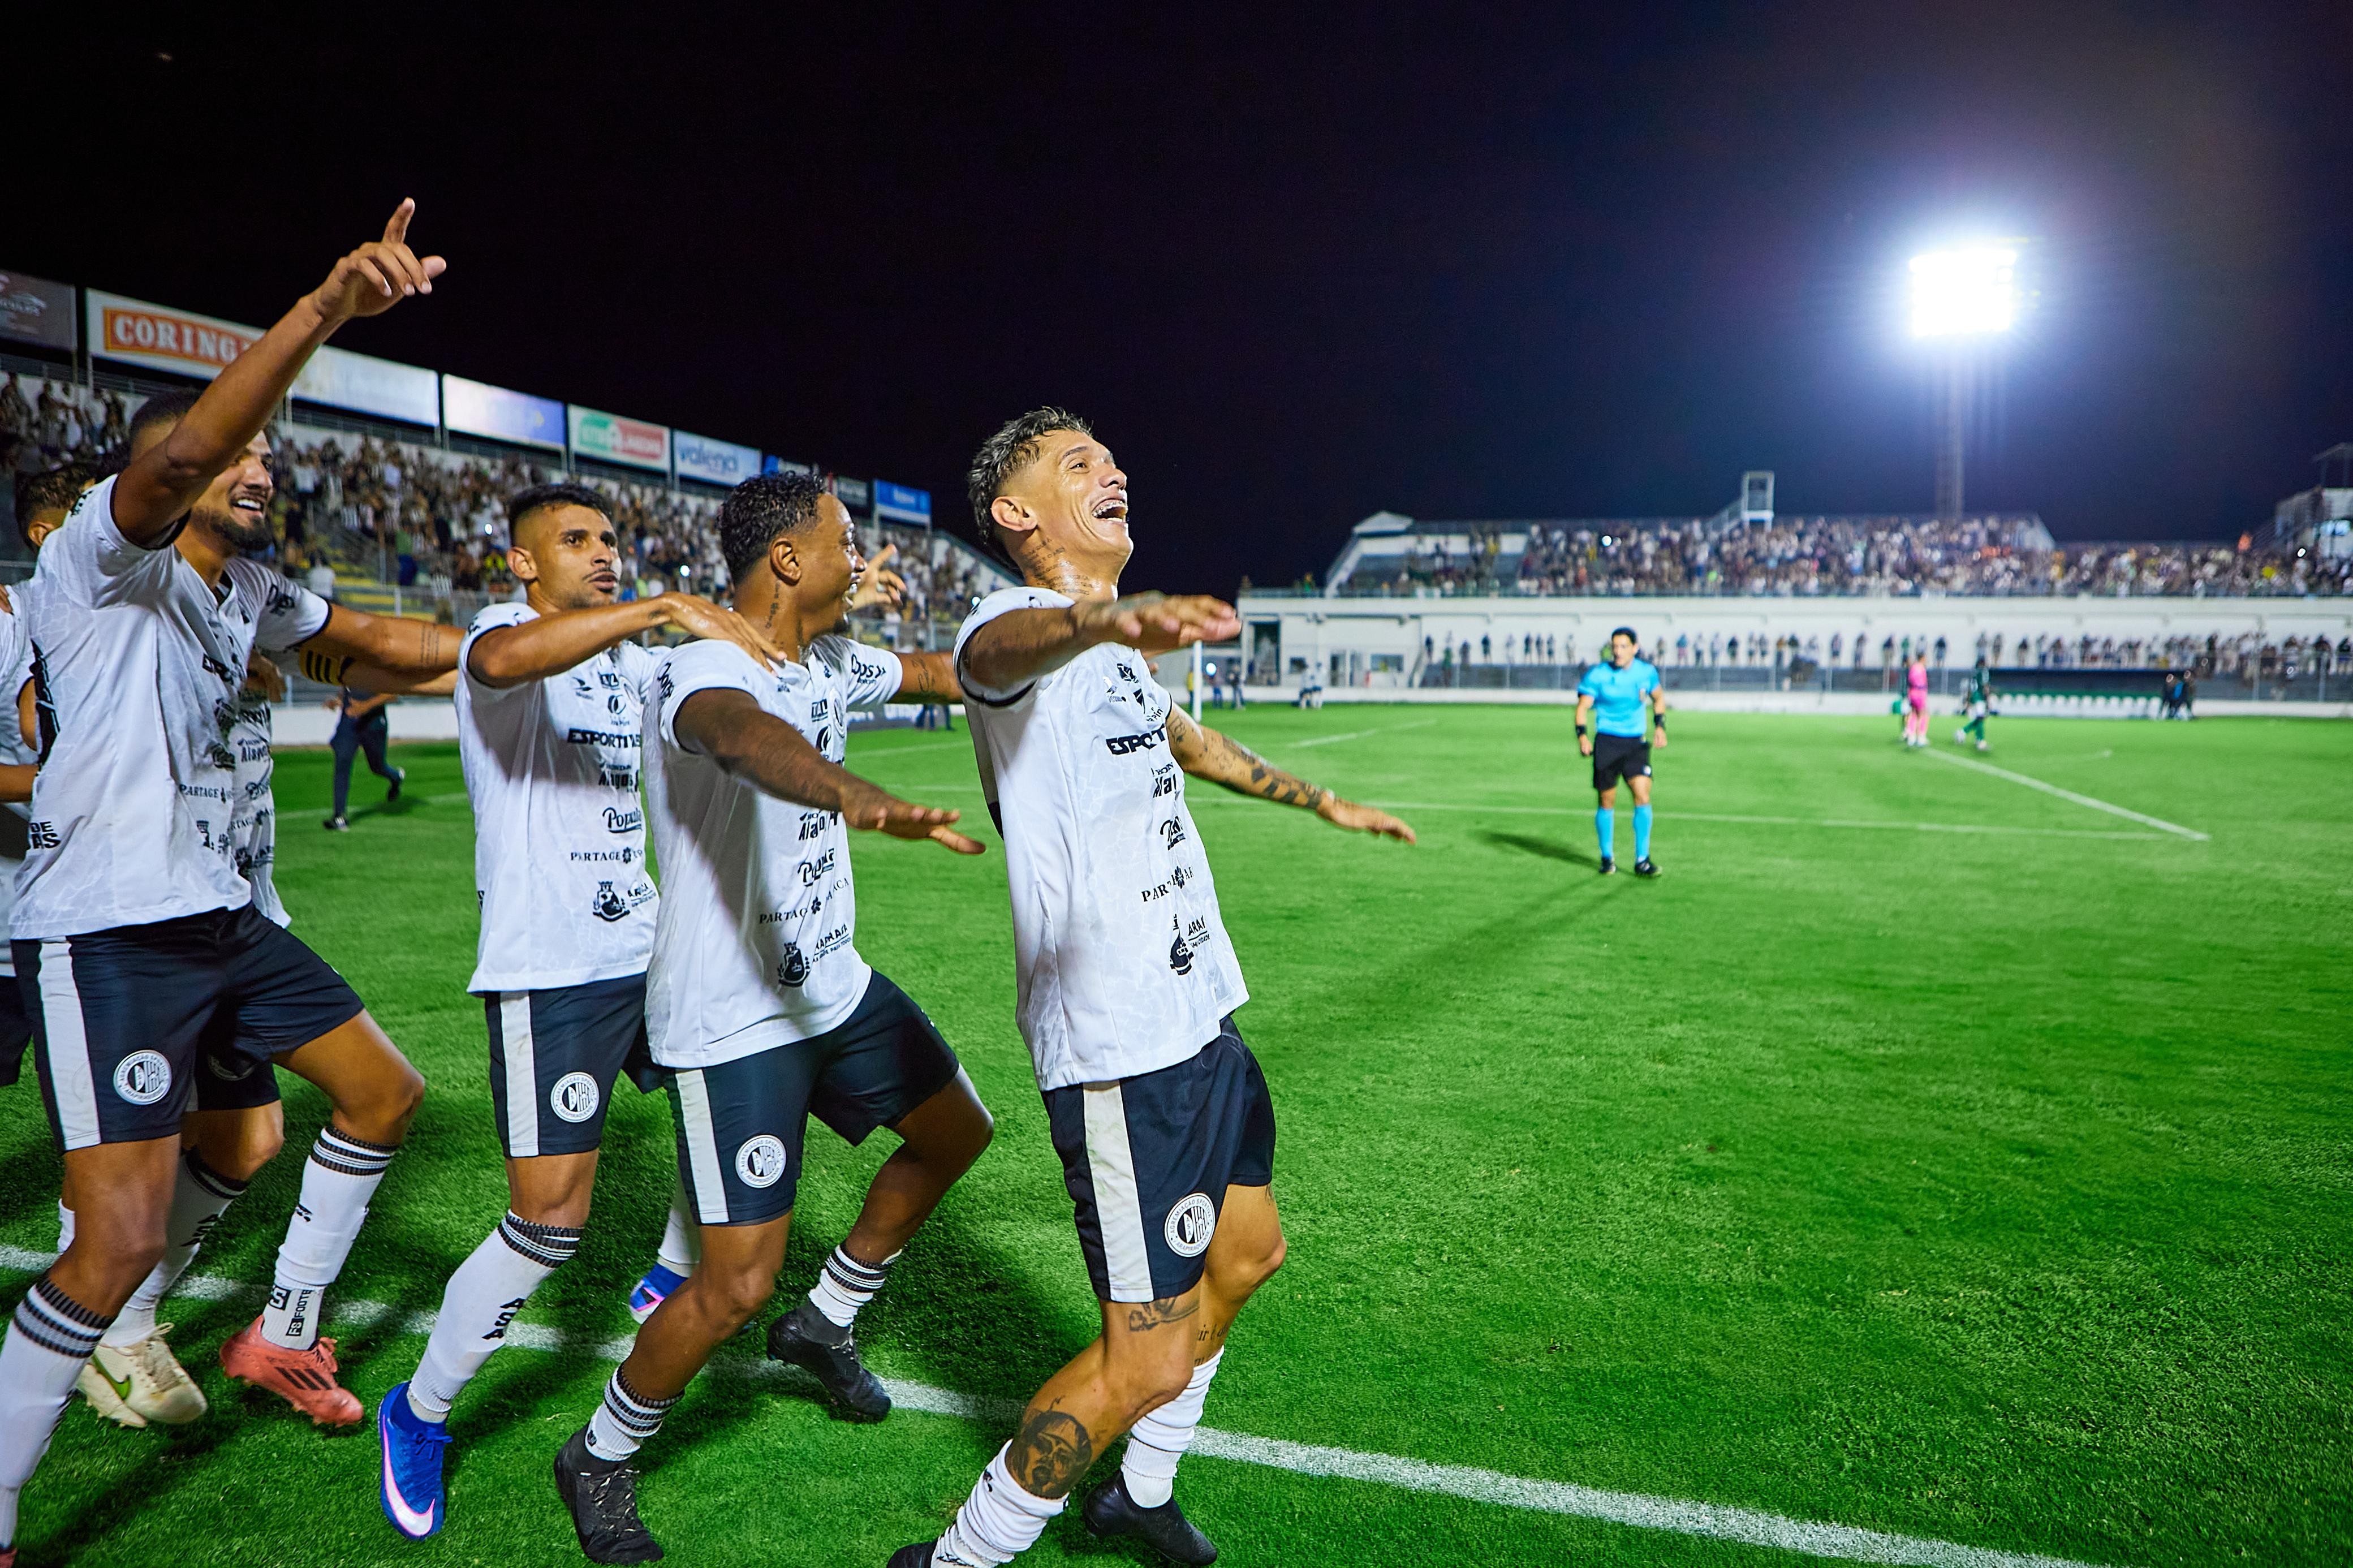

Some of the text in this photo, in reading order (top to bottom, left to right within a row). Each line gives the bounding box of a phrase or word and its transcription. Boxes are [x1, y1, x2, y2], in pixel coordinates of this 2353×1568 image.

[115, 315, 251, 364] CORING
[31, 833, 61, 849] AS
[481, 1298, 525, 1340] ASA
